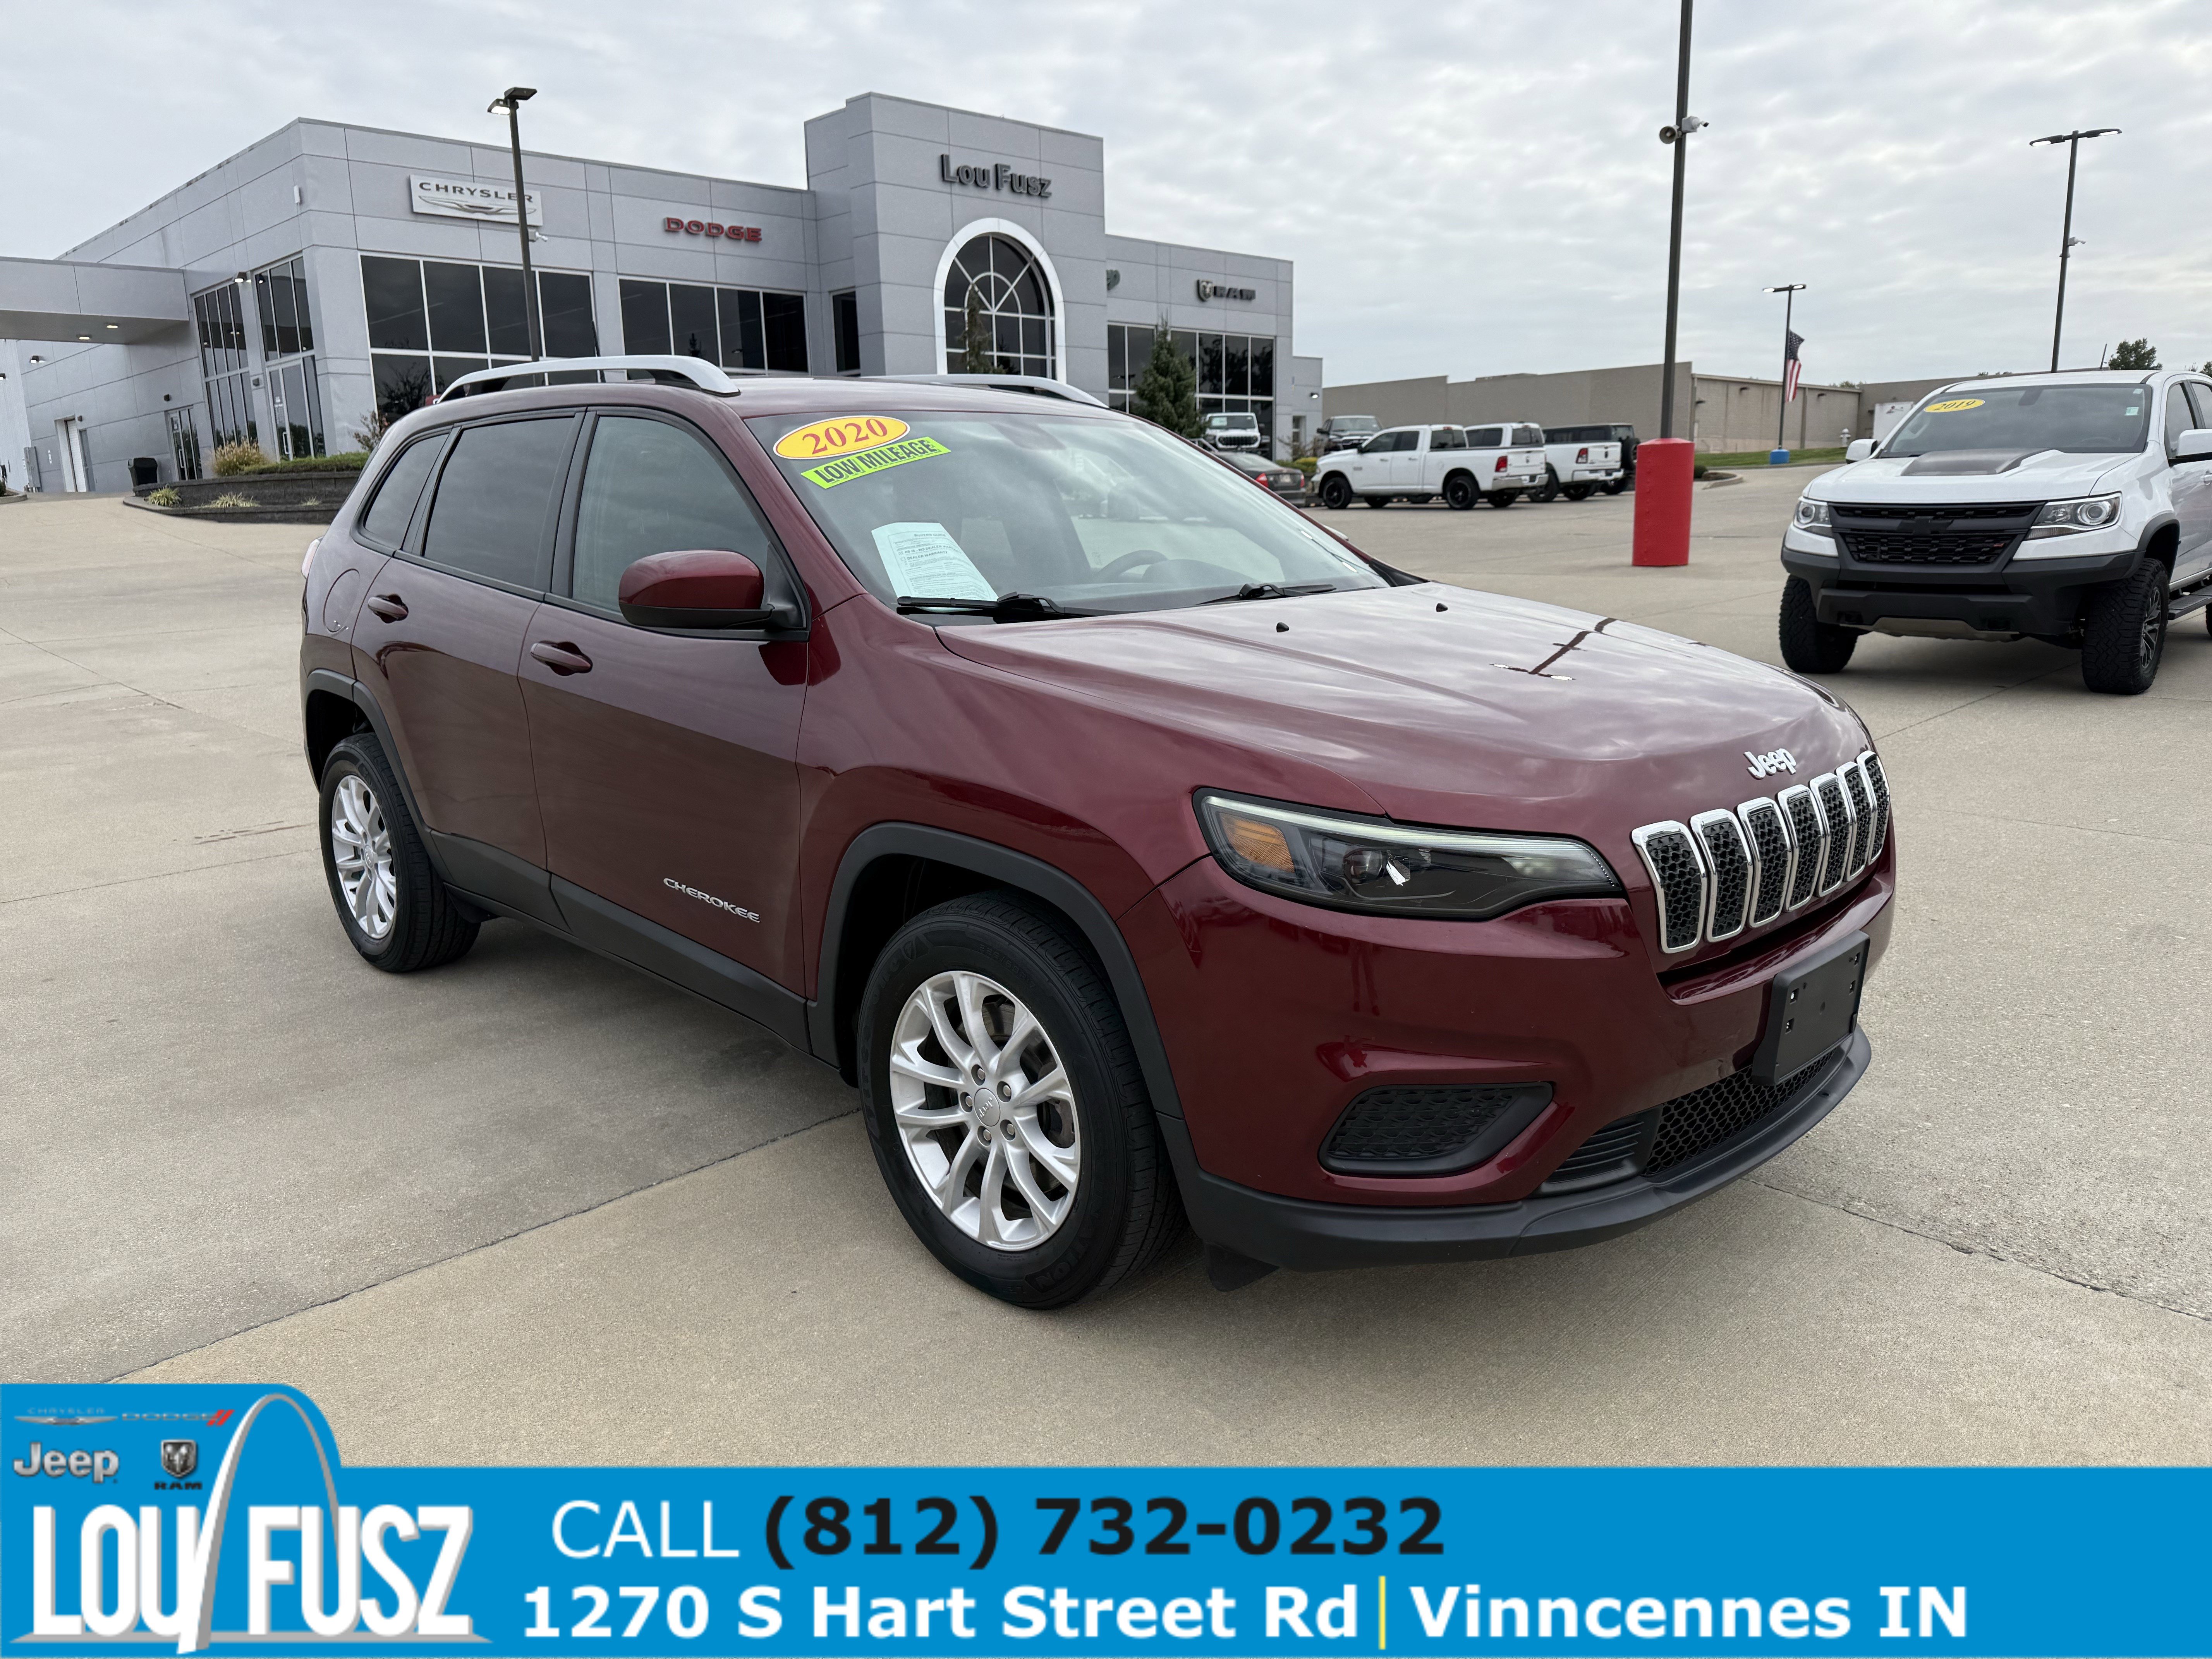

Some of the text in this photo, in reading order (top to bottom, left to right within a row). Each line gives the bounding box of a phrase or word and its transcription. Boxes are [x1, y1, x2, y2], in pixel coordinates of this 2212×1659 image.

[941, 154, 1052, 198] Lou Fusz
[419, 182, 533, 203] CHRYSLER
[664, 217, 762, 242] DODGE
[1213, 285, 1256, 301] RAM
[1933, 400, 1976, 411] 2019
[802, 419, 888, 455] 2020
[814, 440, 938, 483] LOW MILEAGE
[1743, 748, 1797, 779] Jeep
[663, 878, 760, 923] CHEROKEE
[979, 1097, 993, 1117] Jeep
